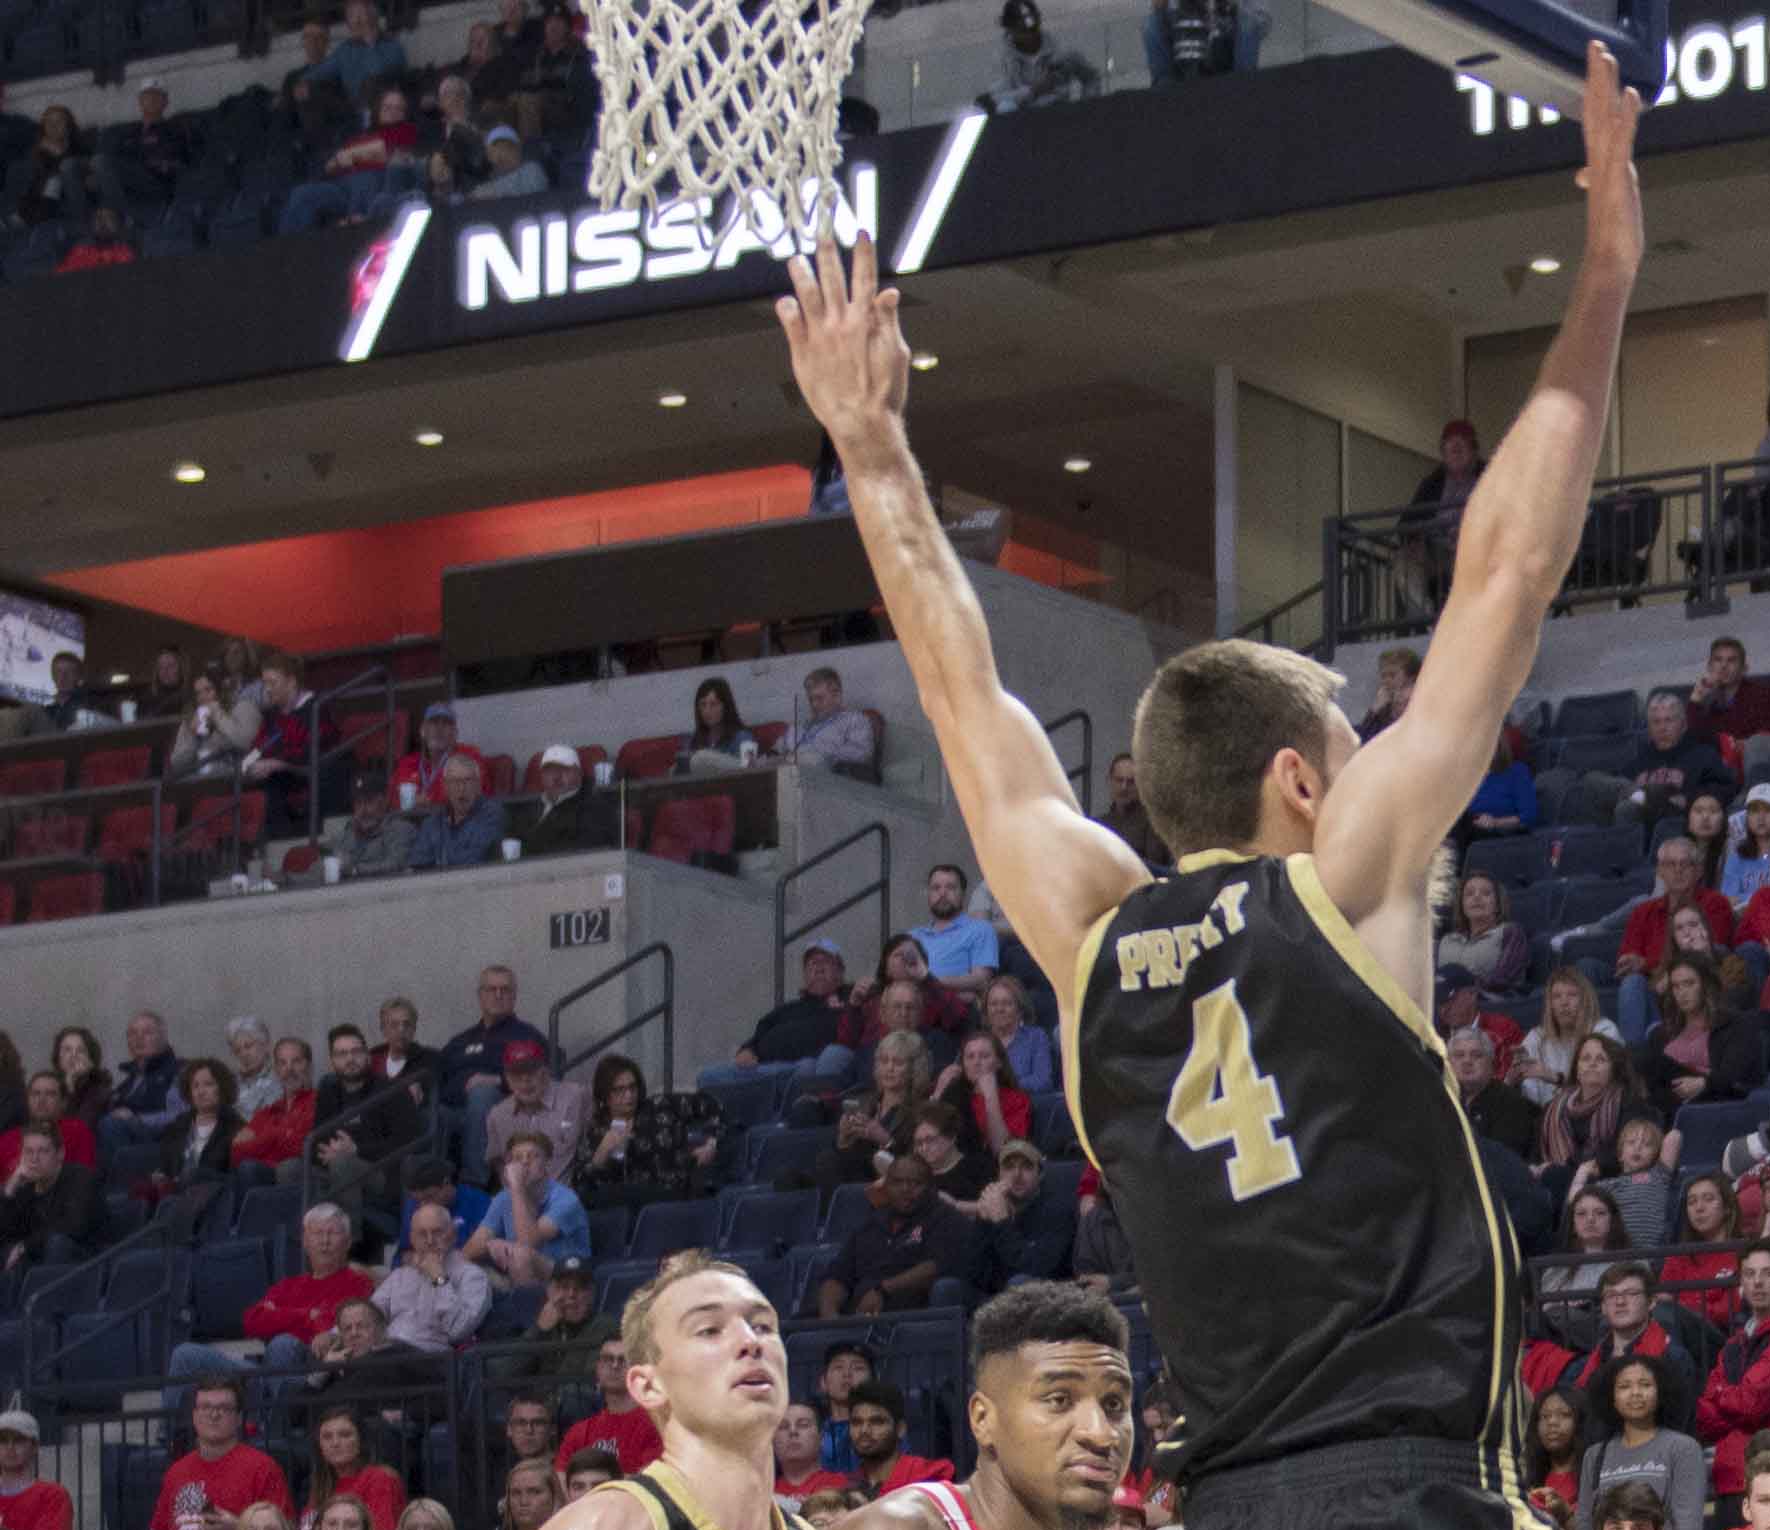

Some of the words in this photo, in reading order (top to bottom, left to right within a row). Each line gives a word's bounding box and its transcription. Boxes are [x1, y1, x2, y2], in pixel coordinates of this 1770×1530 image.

[460, 163, 879, 310] NISSAN
[556, 912, 604, 945] 102
[1166, 978, 1303, 1201] 4
